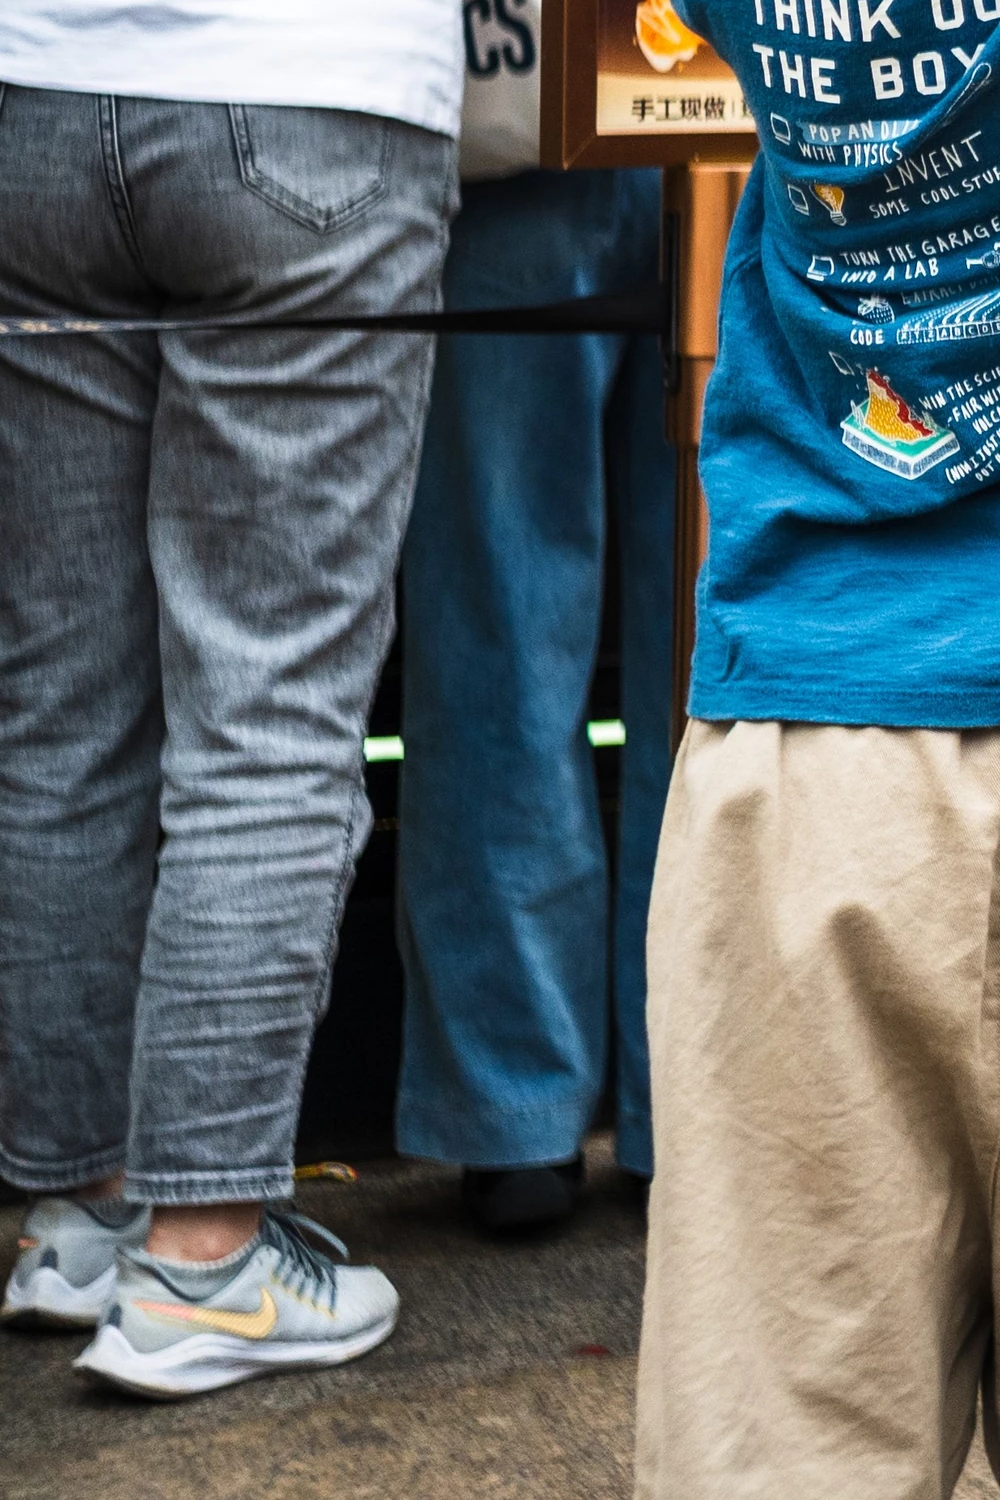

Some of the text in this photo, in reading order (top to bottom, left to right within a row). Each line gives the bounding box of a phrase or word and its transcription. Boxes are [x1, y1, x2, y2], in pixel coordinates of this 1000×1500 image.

[752, 43, 841, 104] THE
[631, 96, 726, 122] 手工现做
[809, 123, 841, 143] POP
[849, 120, 874, 140] AN
[797, 141, 903, 168] WITH PHYSICS
[884, 130, 982, 193] INVENT
[869, 198, 910, 219] SOME
[921, 184, 959, 205] COOL
[840, 249, 880, 267] TURN
[888, 243, 917, 264] THE
[841, 258, 940, 284] INTO A LAB
[850, 329, 885, 346] CODE
[918, 390, 947, 411] WIN
[946, 379, 974, 401] THE
[952, 396, 983, 423] FAIR
